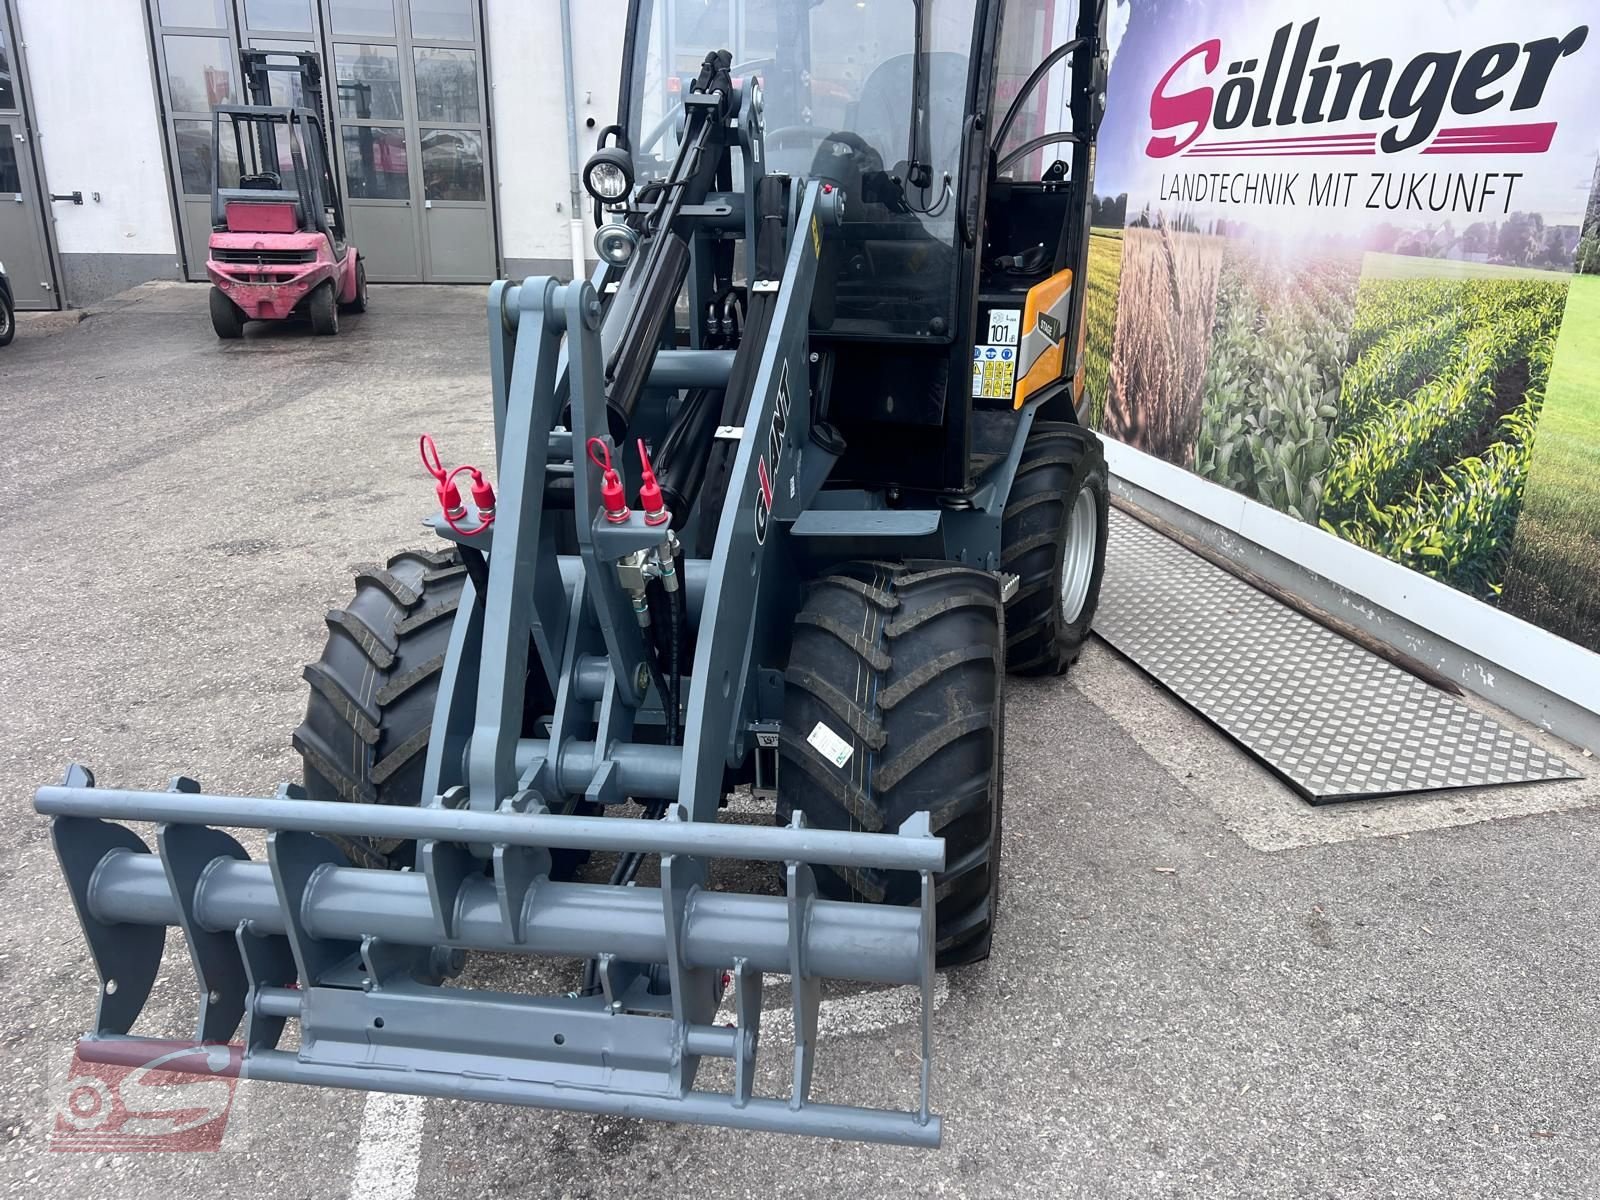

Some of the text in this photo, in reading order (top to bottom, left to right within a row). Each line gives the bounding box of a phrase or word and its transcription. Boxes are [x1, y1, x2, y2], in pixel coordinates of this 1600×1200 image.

[1145, 16, 1589, 159] Söllinger
[1159, 172, 1524, 214] LANDTECHNIK MIT ZUKUNFT
[991, 324, 1009, 343] 101
[754, 357, 791, 546] GIANT
